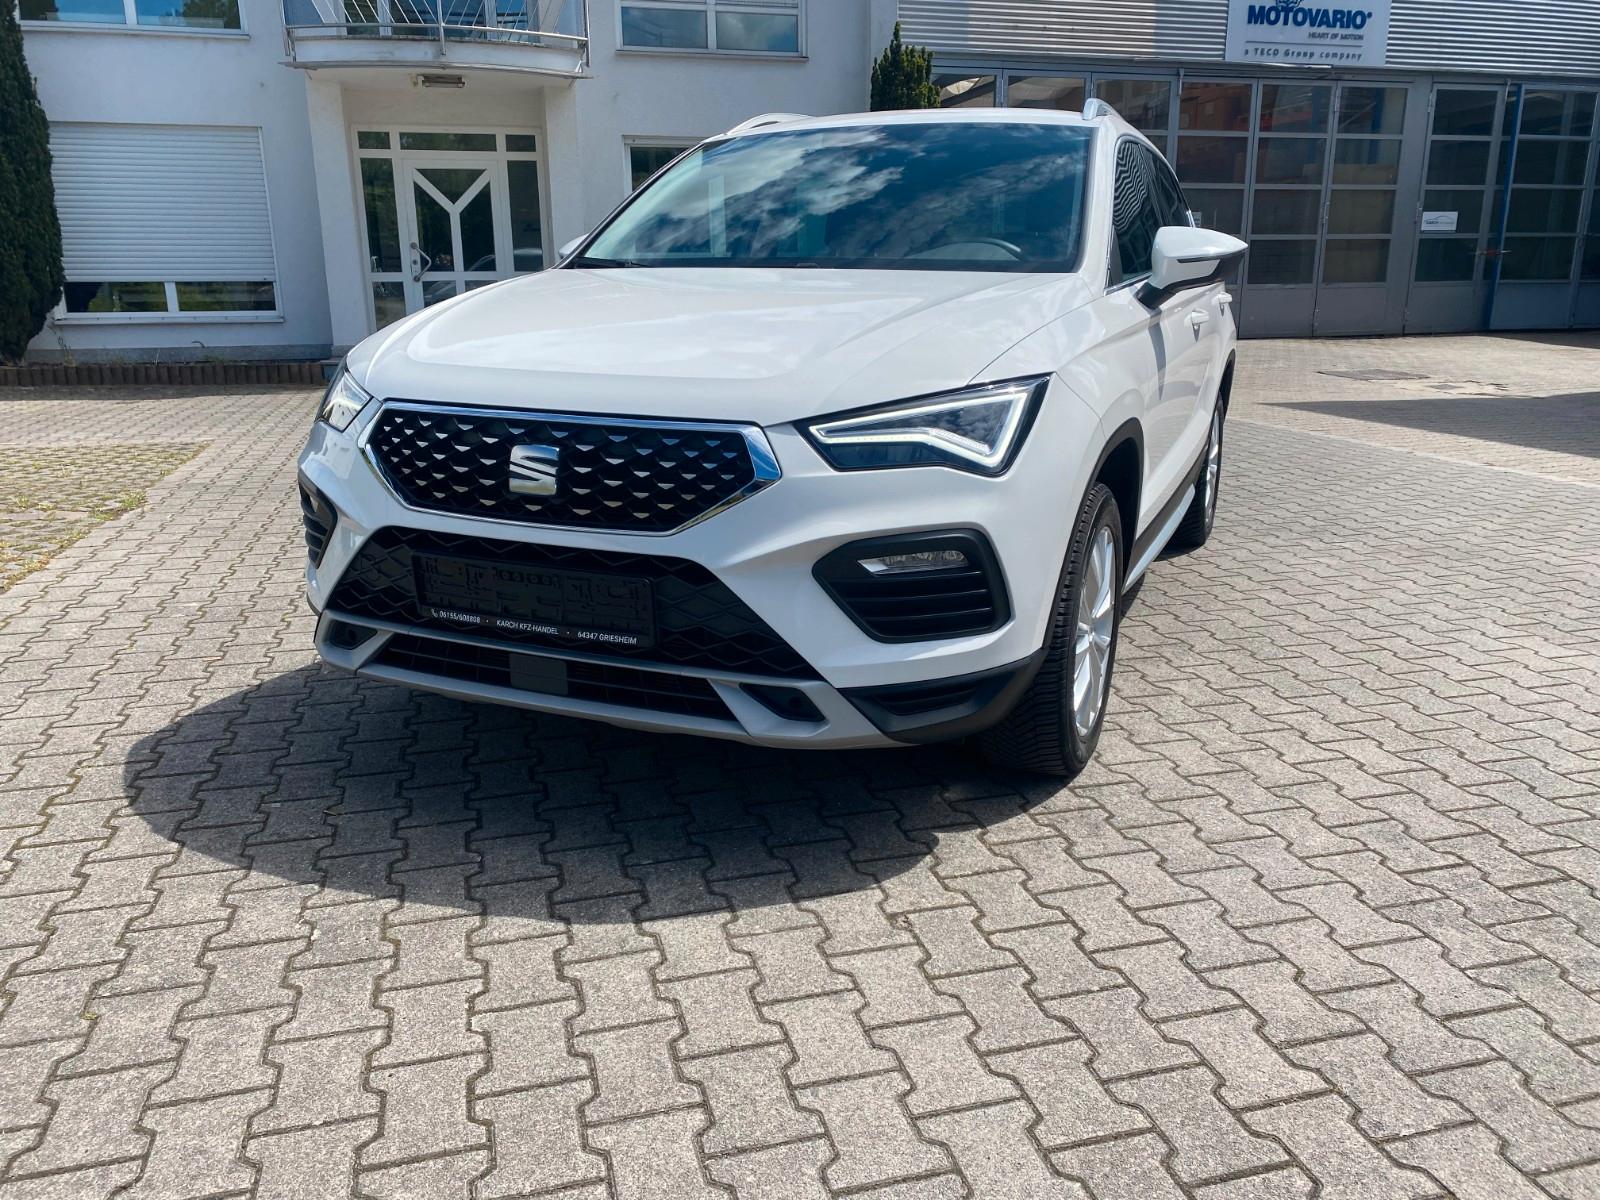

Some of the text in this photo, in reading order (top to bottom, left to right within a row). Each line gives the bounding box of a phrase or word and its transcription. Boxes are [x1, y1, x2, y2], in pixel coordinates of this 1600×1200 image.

[1247, 5, 1367, 29] MOTOVARIO
[1308, 32, 1329, 40] HEART
[1254, 48, 1279, 57] TECO
[1284, 49, 1314, 59] Group
[1320, 52, 1362, 60] company
[577, 631, 598, 640] 64347
[599, 633, 637, 645] GRIESHEIM
